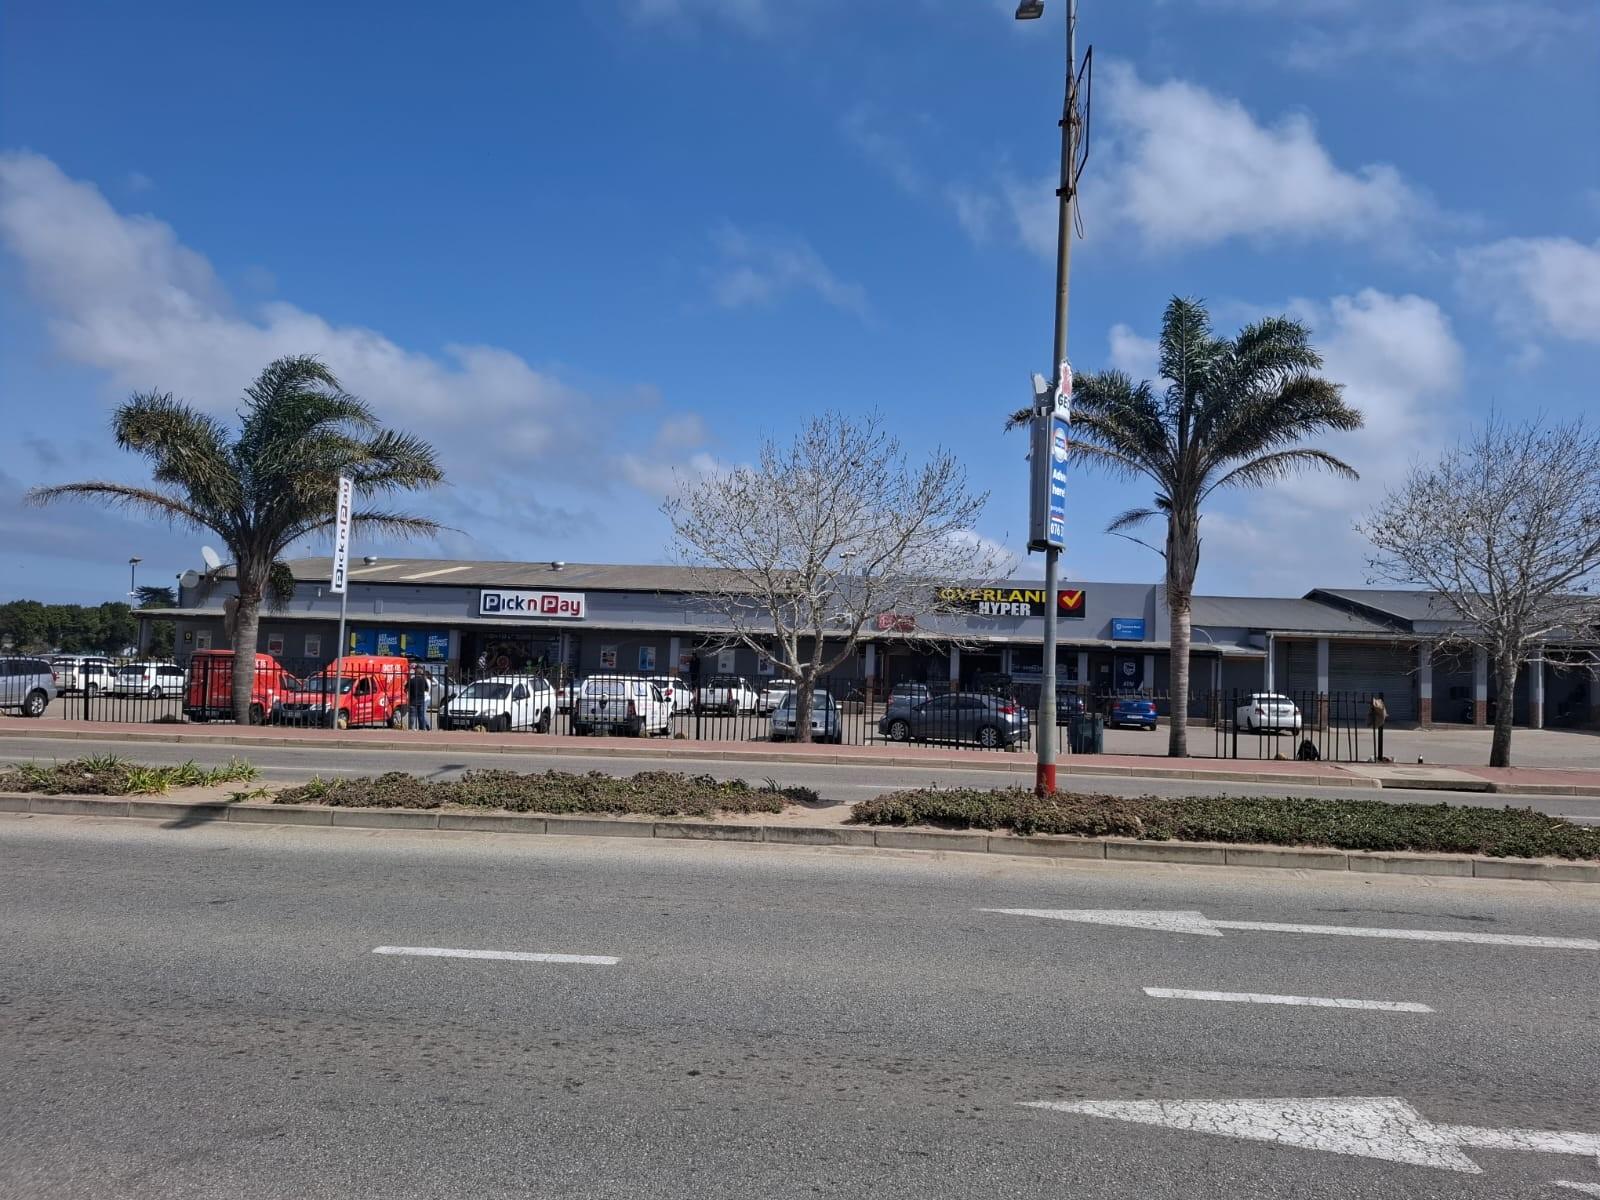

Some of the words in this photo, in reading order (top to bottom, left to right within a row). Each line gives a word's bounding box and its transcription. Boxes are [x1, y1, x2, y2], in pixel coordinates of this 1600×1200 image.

[484, 593, 525, 611] Pick
[527, 598, 537, 611] n
[541, 595, 580, 616] Pay
[978, 600, 1031, 616] HYPER
